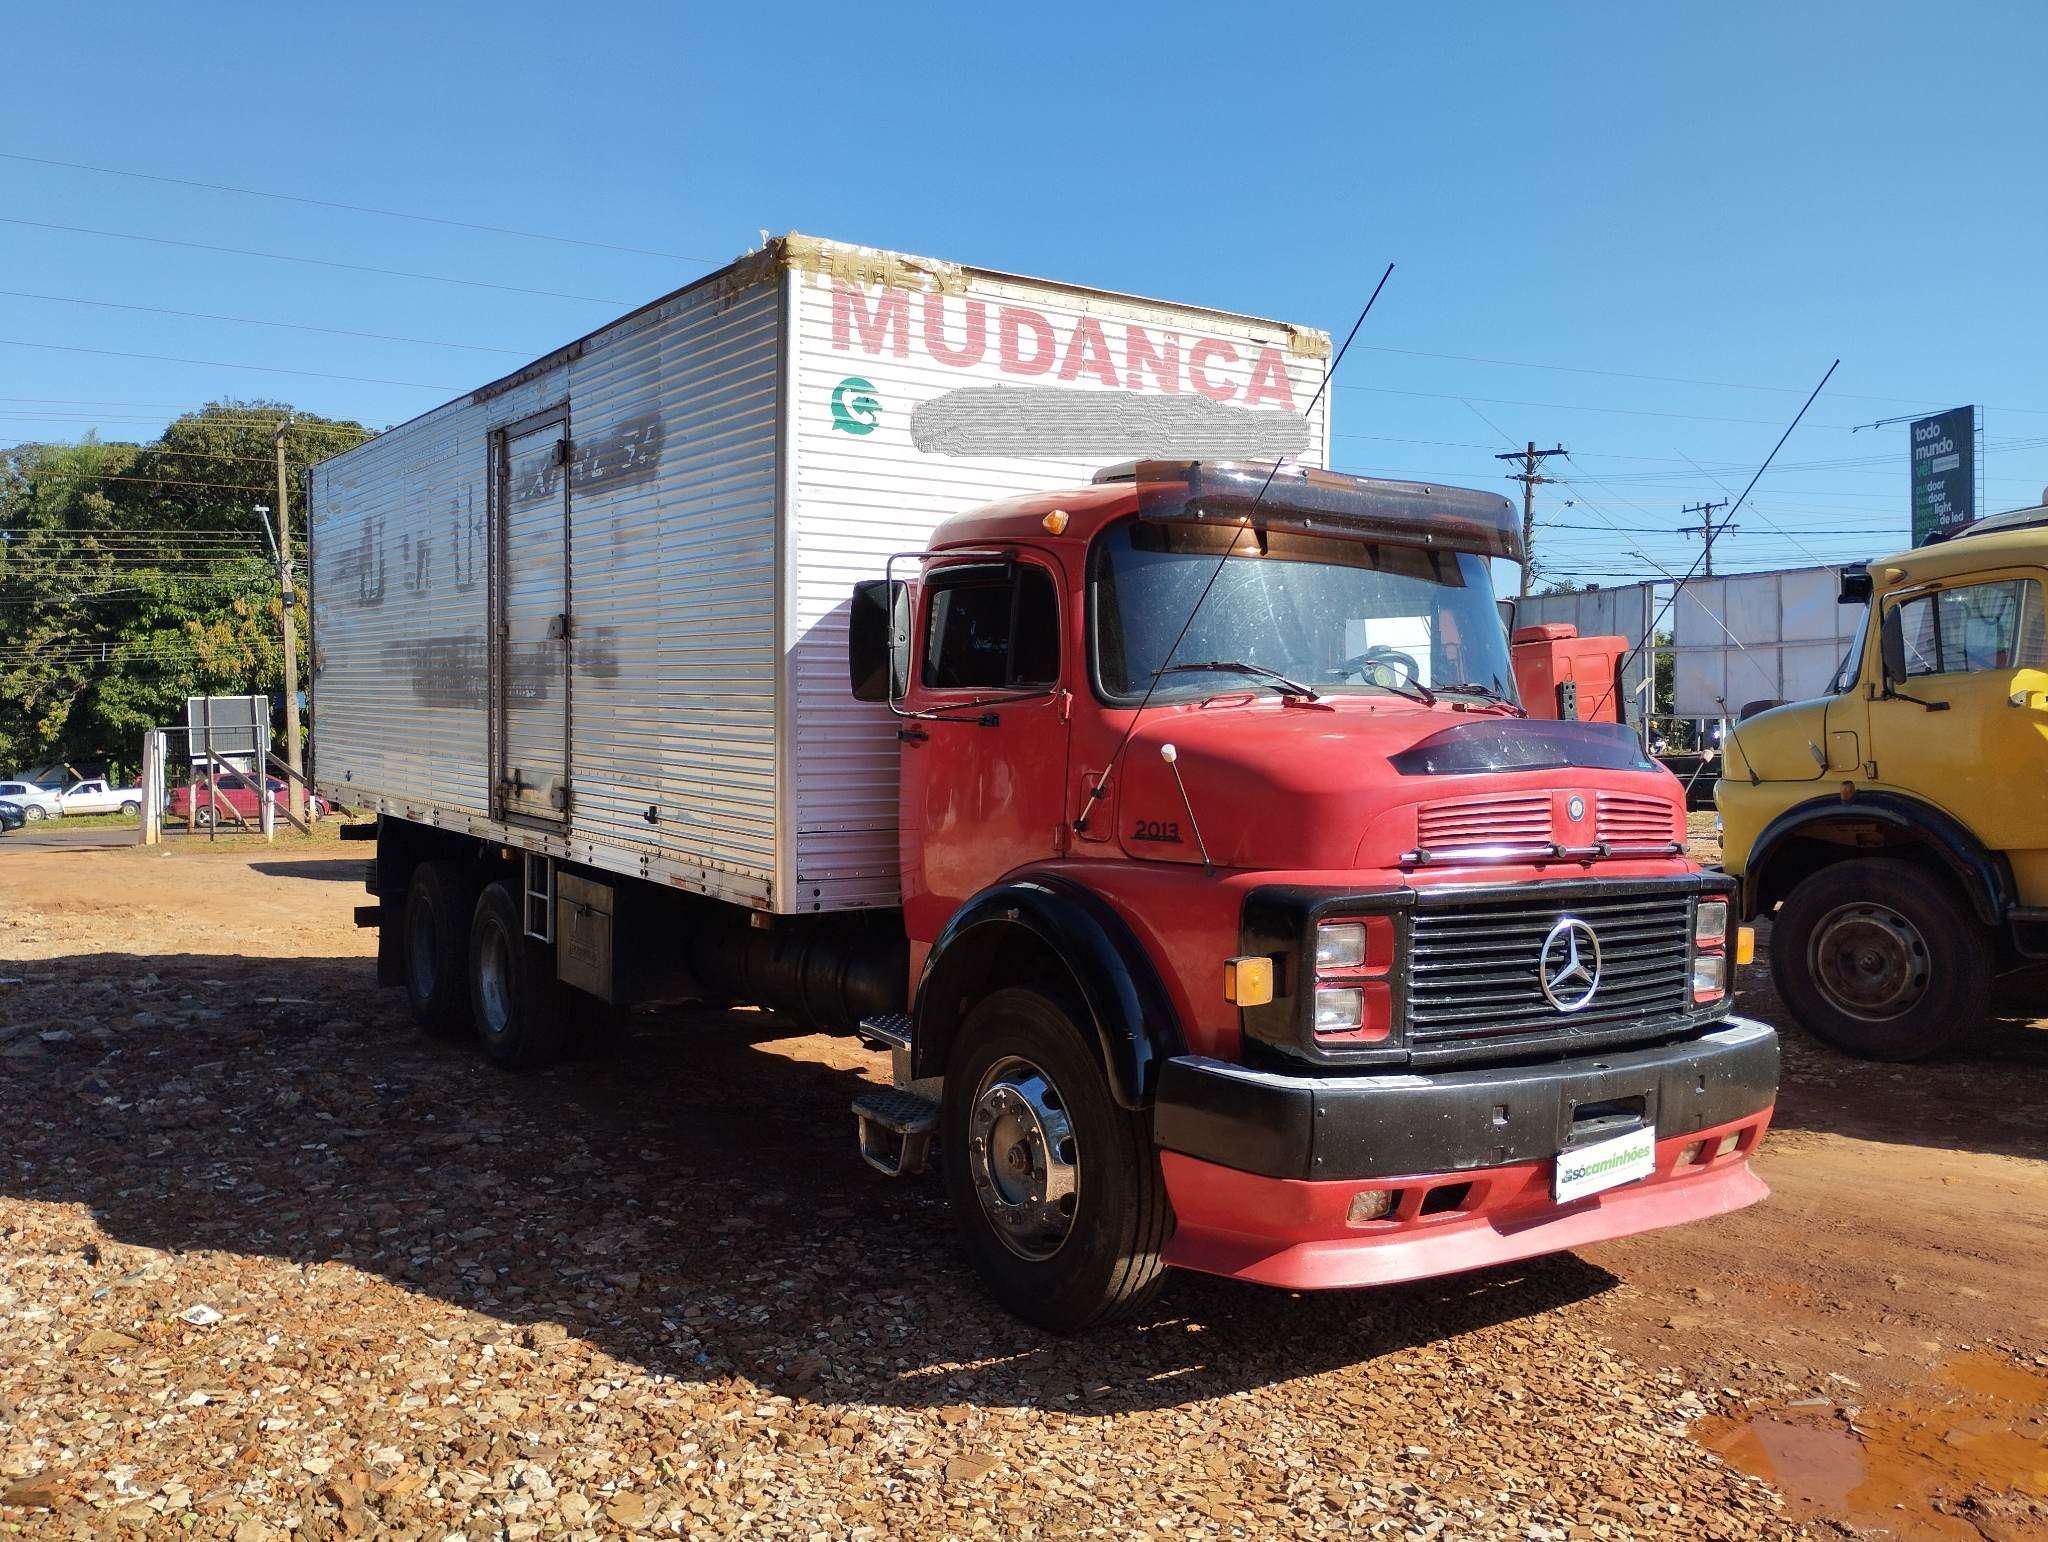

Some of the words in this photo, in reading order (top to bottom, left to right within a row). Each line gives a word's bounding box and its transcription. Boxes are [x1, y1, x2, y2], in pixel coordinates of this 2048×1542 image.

[1915, 422, 1940, 442] todo
[1915, 437, 1953, 460] mundo
[1939, 513, 1950, 525] de
[1951, 511, 1964, 523] led
[1135, 820, 1179, 837] 2013
